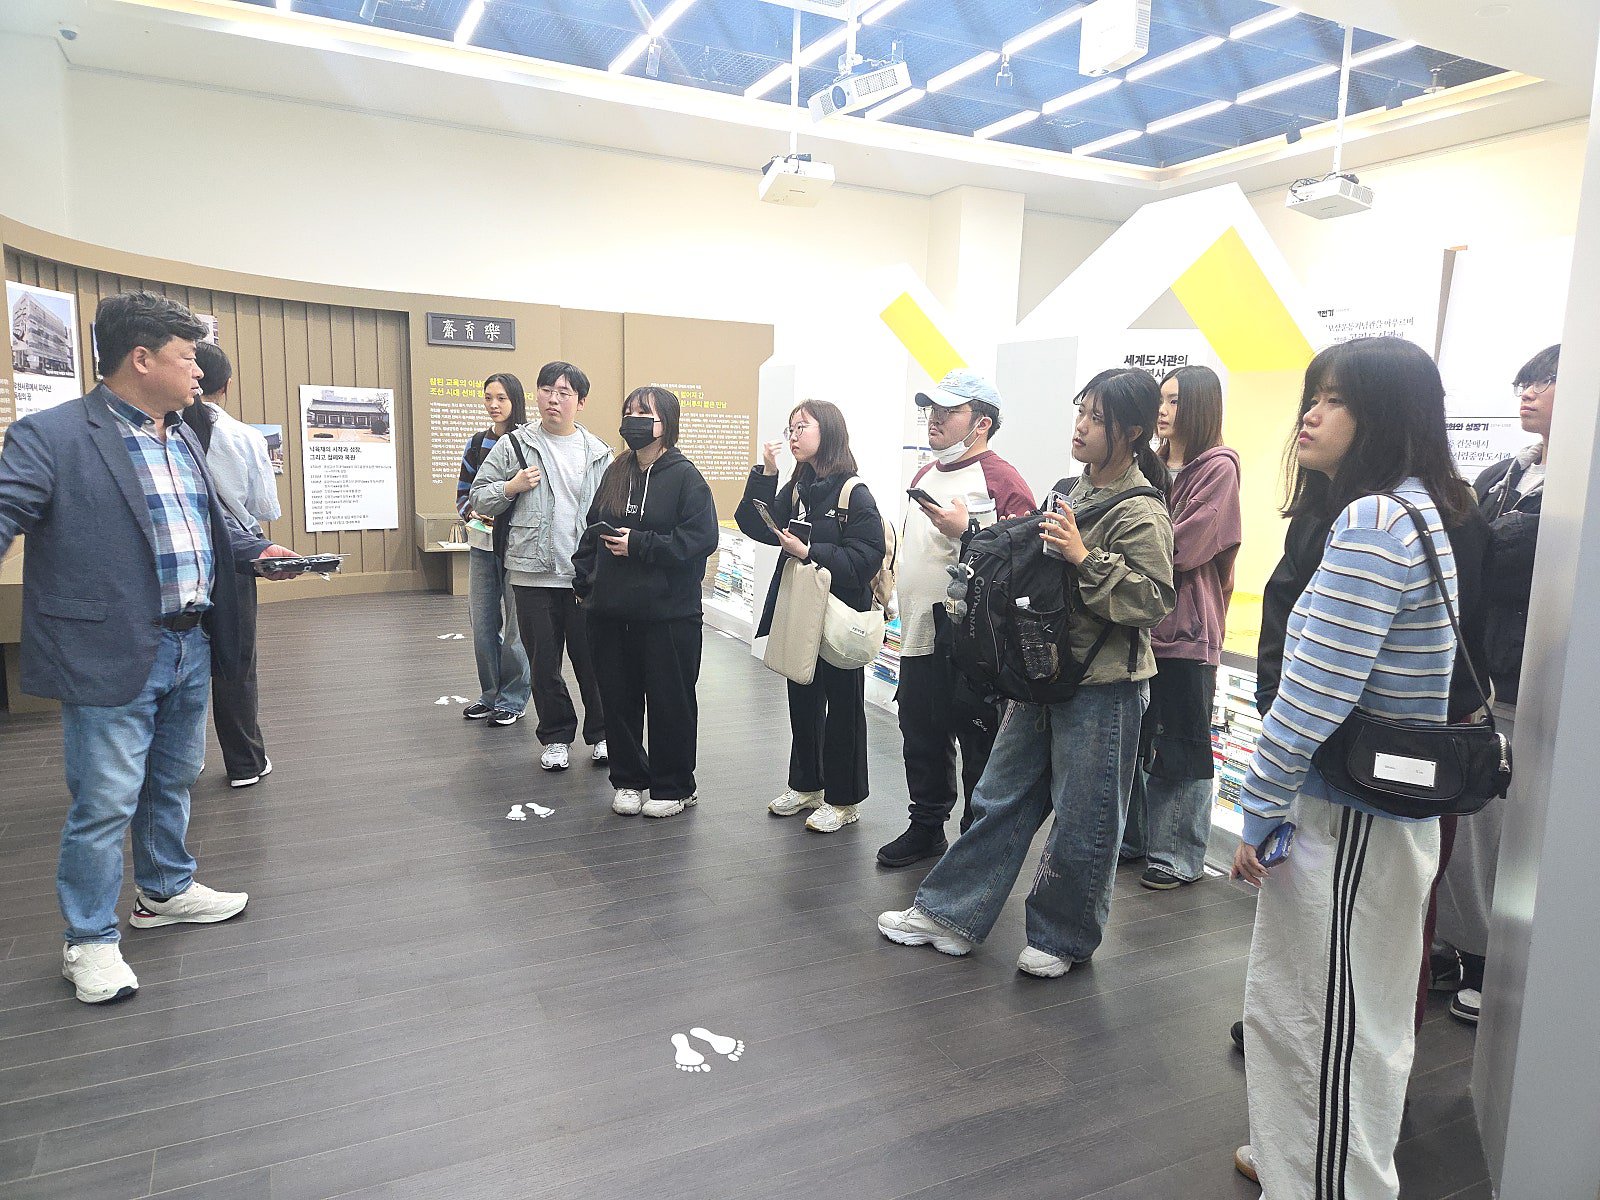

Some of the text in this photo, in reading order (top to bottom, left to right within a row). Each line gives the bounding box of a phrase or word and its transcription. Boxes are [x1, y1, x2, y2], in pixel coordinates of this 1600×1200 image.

[1123, 354, 1188, 367] 세계도서관의
[429, 377, 444, 386] 참된
[446, 379, 467, 388] 교육의
[430, 387, 444, 396] 조선
[446, 389, 460, 398] 시대
[462, 390, 476, 398] 선비
[1446, 422, 1464, 431] 화와
[1465, 422, 1489, 431] 성장기
[1457, 439, 1489, 449] 건물에서
[969, 576, 985, 639] COVERNAT
